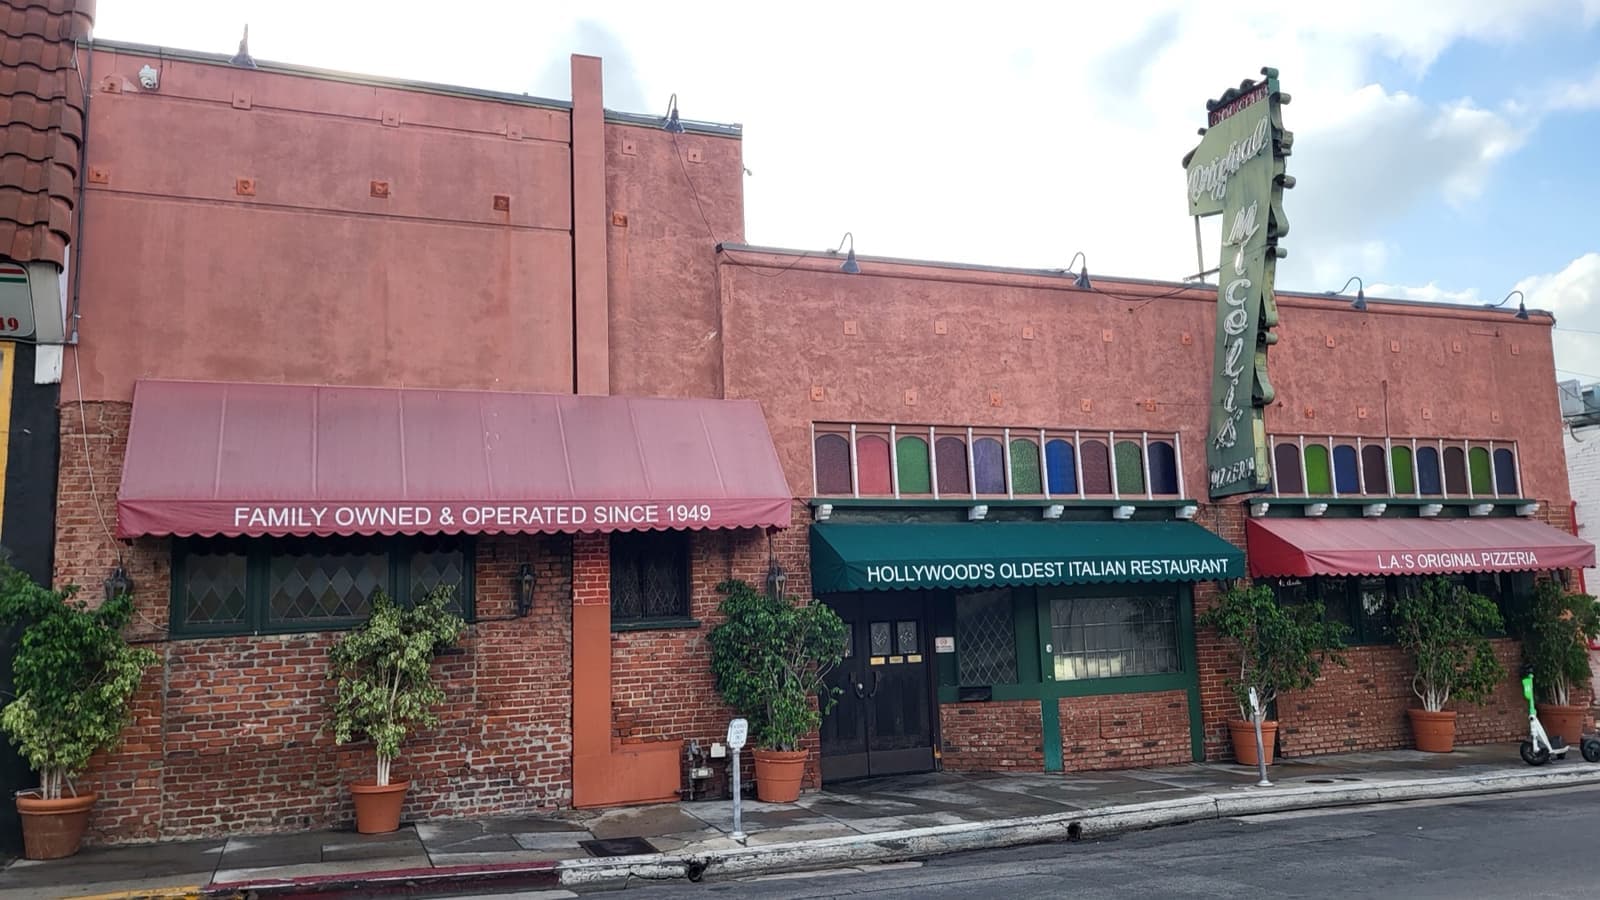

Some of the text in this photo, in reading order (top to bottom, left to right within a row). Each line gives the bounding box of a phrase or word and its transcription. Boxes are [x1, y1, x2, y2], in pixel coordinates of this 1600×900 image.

[1188, 116, 1268, 200] Original
[235, 504, 711, 527] FAMILY OWNED & OPERATED SINCE 1949
[867, 558, 1229, 582] HOLLYWOOD'S OLDEST ITALIAN RESTAURANT
[1417, 553, 1481, 569] ORIGINAL
[1482, 551, 1538, 566] PIZZERIA
